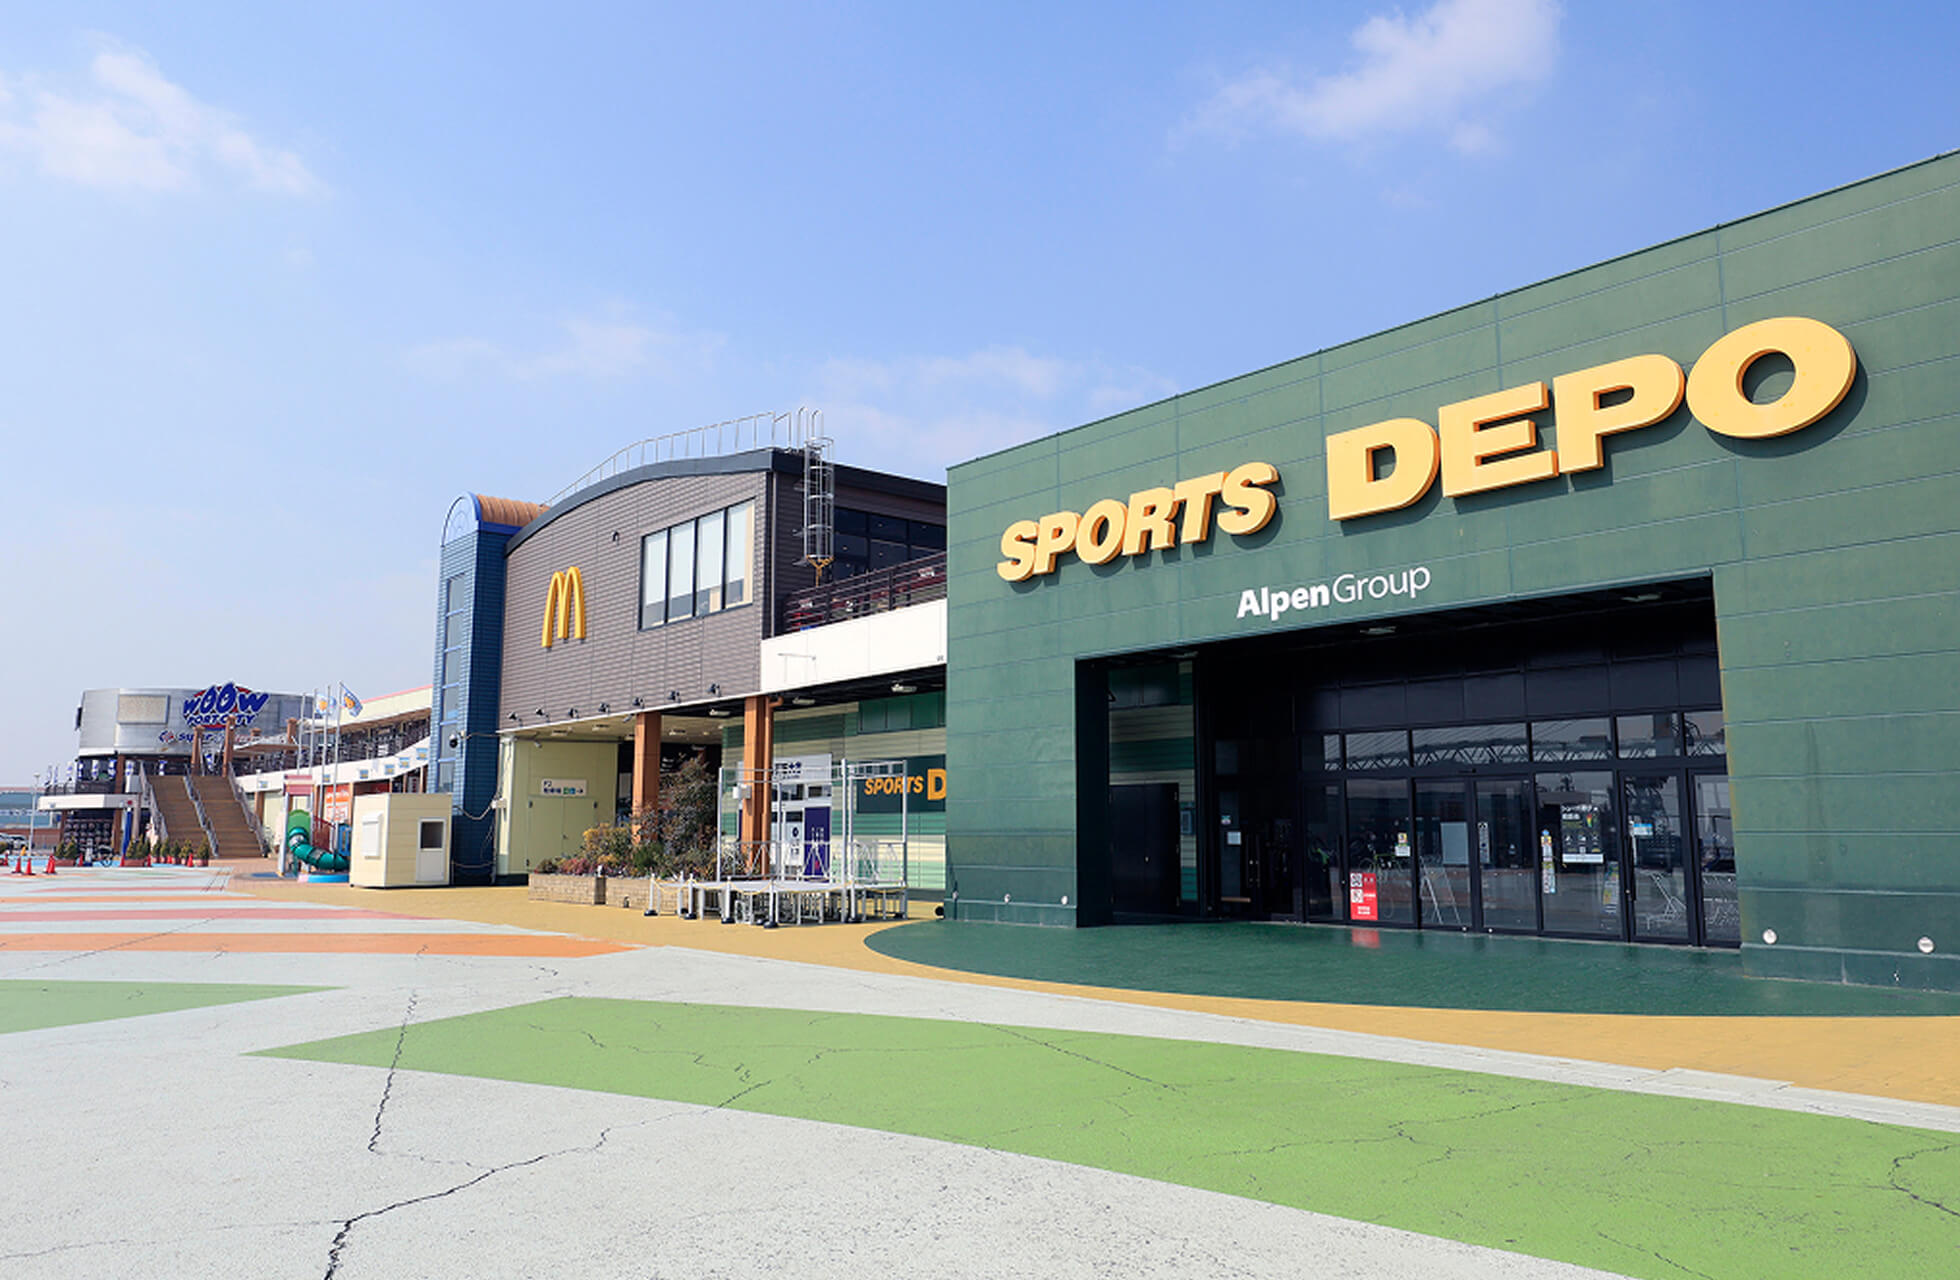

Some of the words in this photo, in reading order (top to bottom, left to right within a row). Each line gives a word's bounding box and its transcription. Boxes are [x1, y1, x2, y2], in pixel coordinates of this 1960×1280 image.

[997, 462, 1279, 582] SPORTS
[1326, 316, 1857, 520] DEPO
[1236, 583, 1330, 621] Alpen
[1332, 566, 1431, 603] Group
[864, 775, 925, 796] SPORTS
